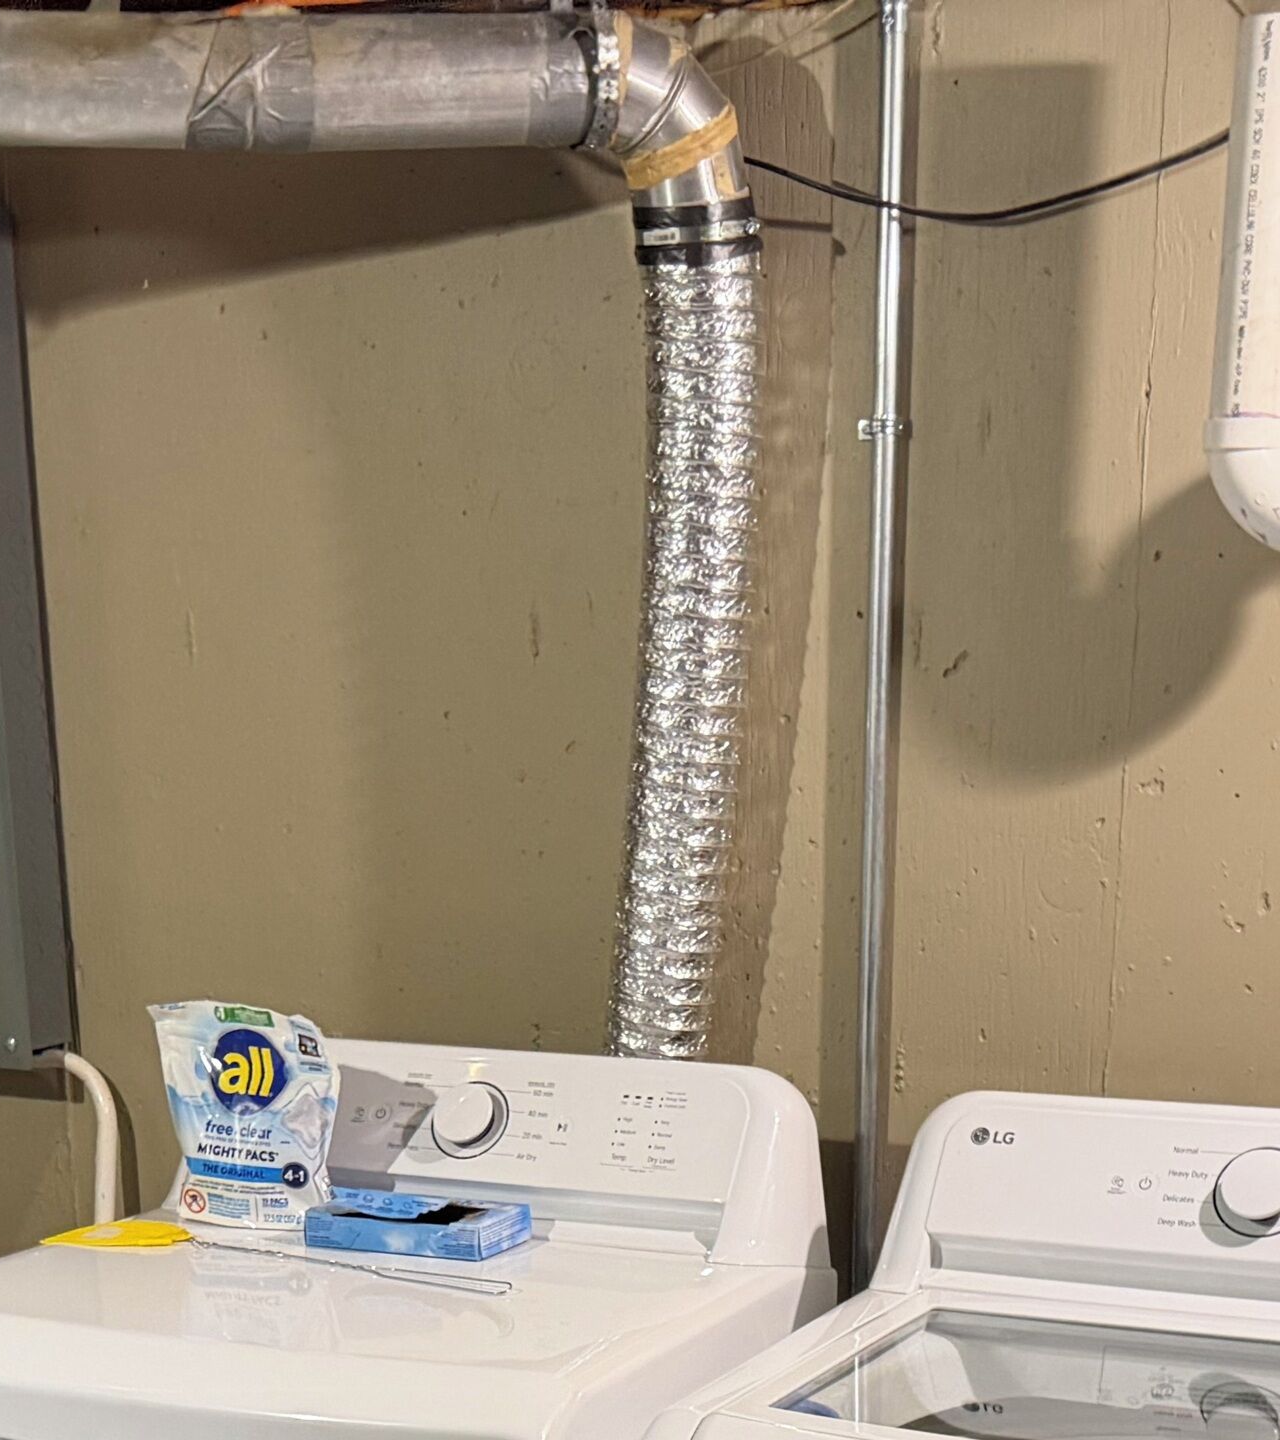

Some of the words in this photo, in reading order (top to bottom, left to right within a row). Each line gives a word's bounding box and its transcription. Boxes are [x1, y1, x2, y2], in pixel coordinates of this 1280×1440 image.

[218, 1046, 275, 1098] all
[205, 1120, 234, 1137] free
[240, 1122, 273, 1140] clear
[992, 1130, 1015, 1145] LG
[197, 1143, 243, 1160] MIGHTY
[245, 1149, 276, 1163] PACS
[1173, 1146, 1200, 1154] Normal
[203, 1162, 220, 1174] THE
[221, 1165, 265, 1180] ORIGINAL
[1168, 1169, 1189, 1179] Heavy
[1191, 1170, 1208, 1180] Duty
[1162, 1193, 1195, 1203] Delicates
[1157, 1218, 1176, 1227] Deep
[1178, 1219, 1196, 1228] Wash
